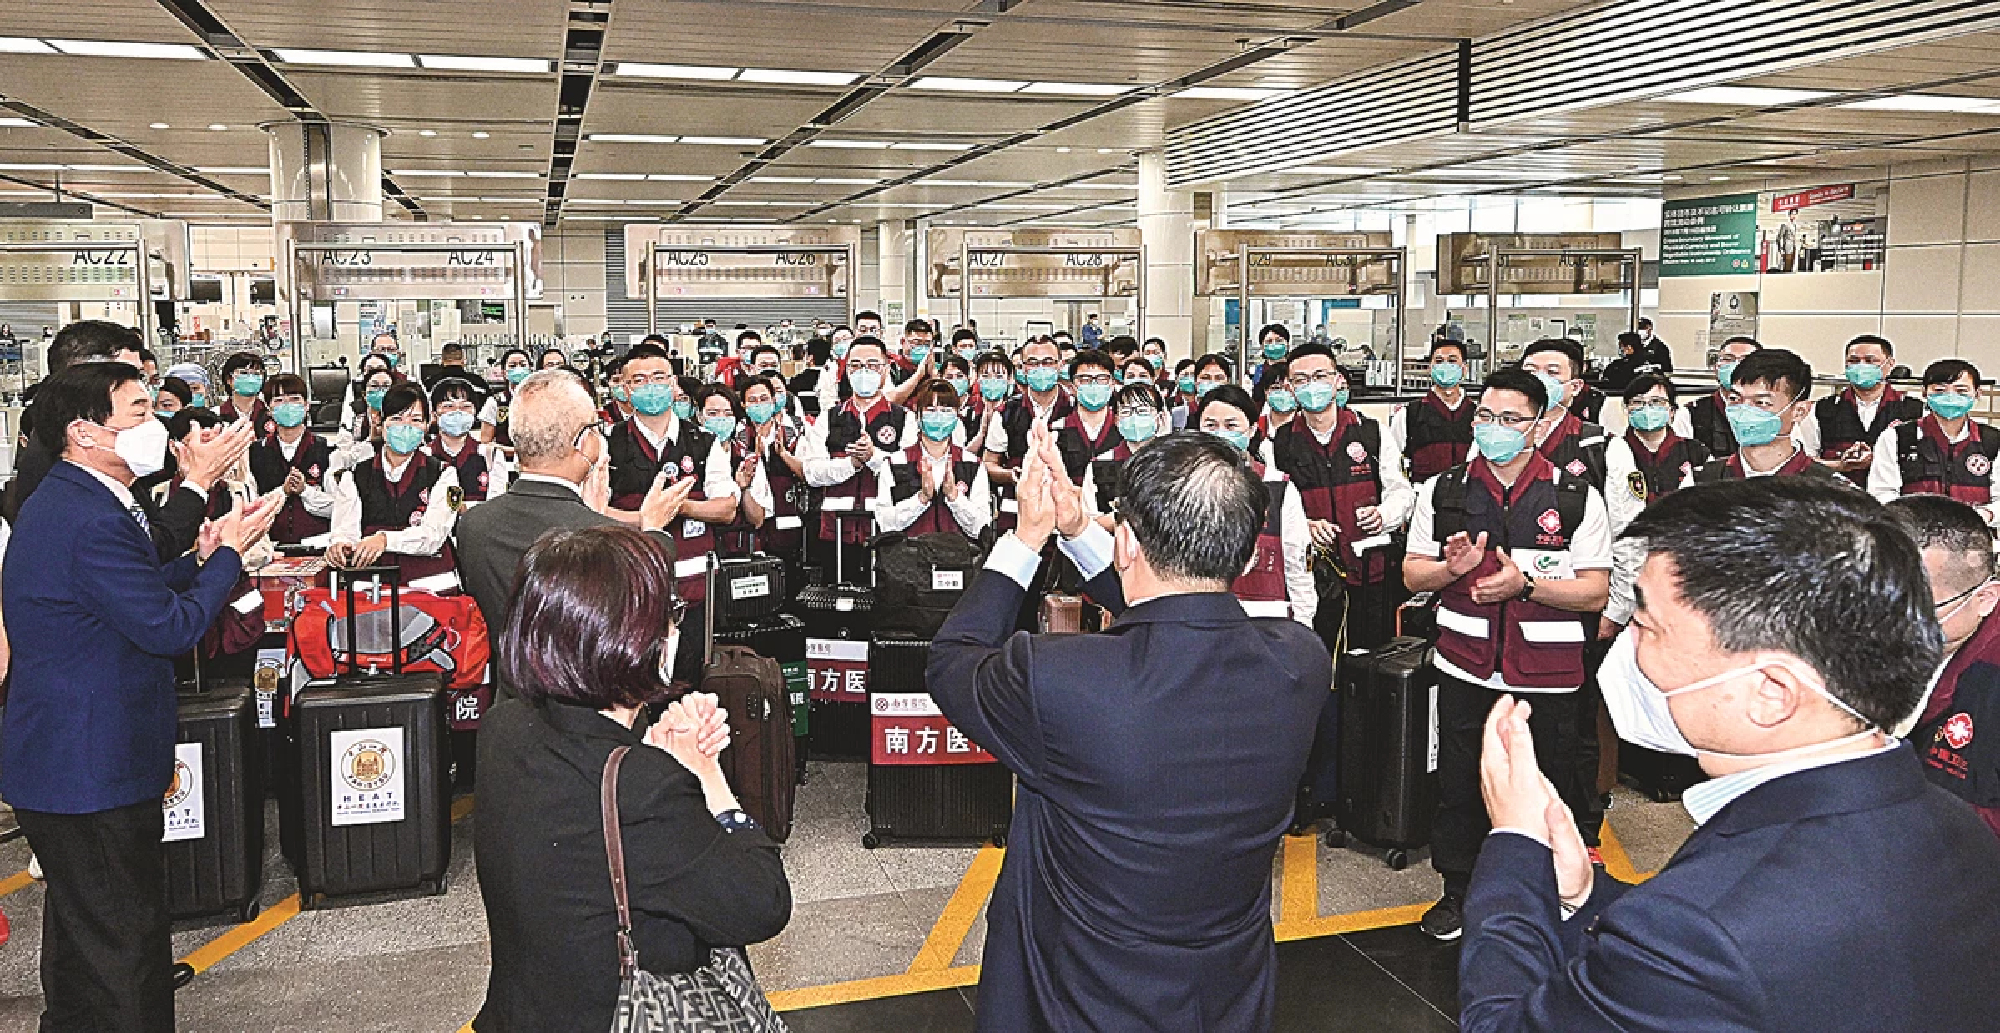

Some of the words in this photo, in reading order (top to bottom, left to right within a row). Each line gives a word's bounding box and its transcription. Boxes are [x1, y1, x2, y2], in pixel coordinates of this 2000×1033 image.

[73, 249, 128, 264] AC22
[322, 250, 371, 265] AC23
[449, 250, 495, 265] AC24
[668, 252, 708, 265] AC25
[968, 253, 1005, 266] AC27
[1067, 253, 1103, 266] AC28
[456, 694, 480, 721] 院
[884, 725, 984, 754] 南方医
[343, 791, 393, 803] HEAT
[168, 808, 191, 819] AT
